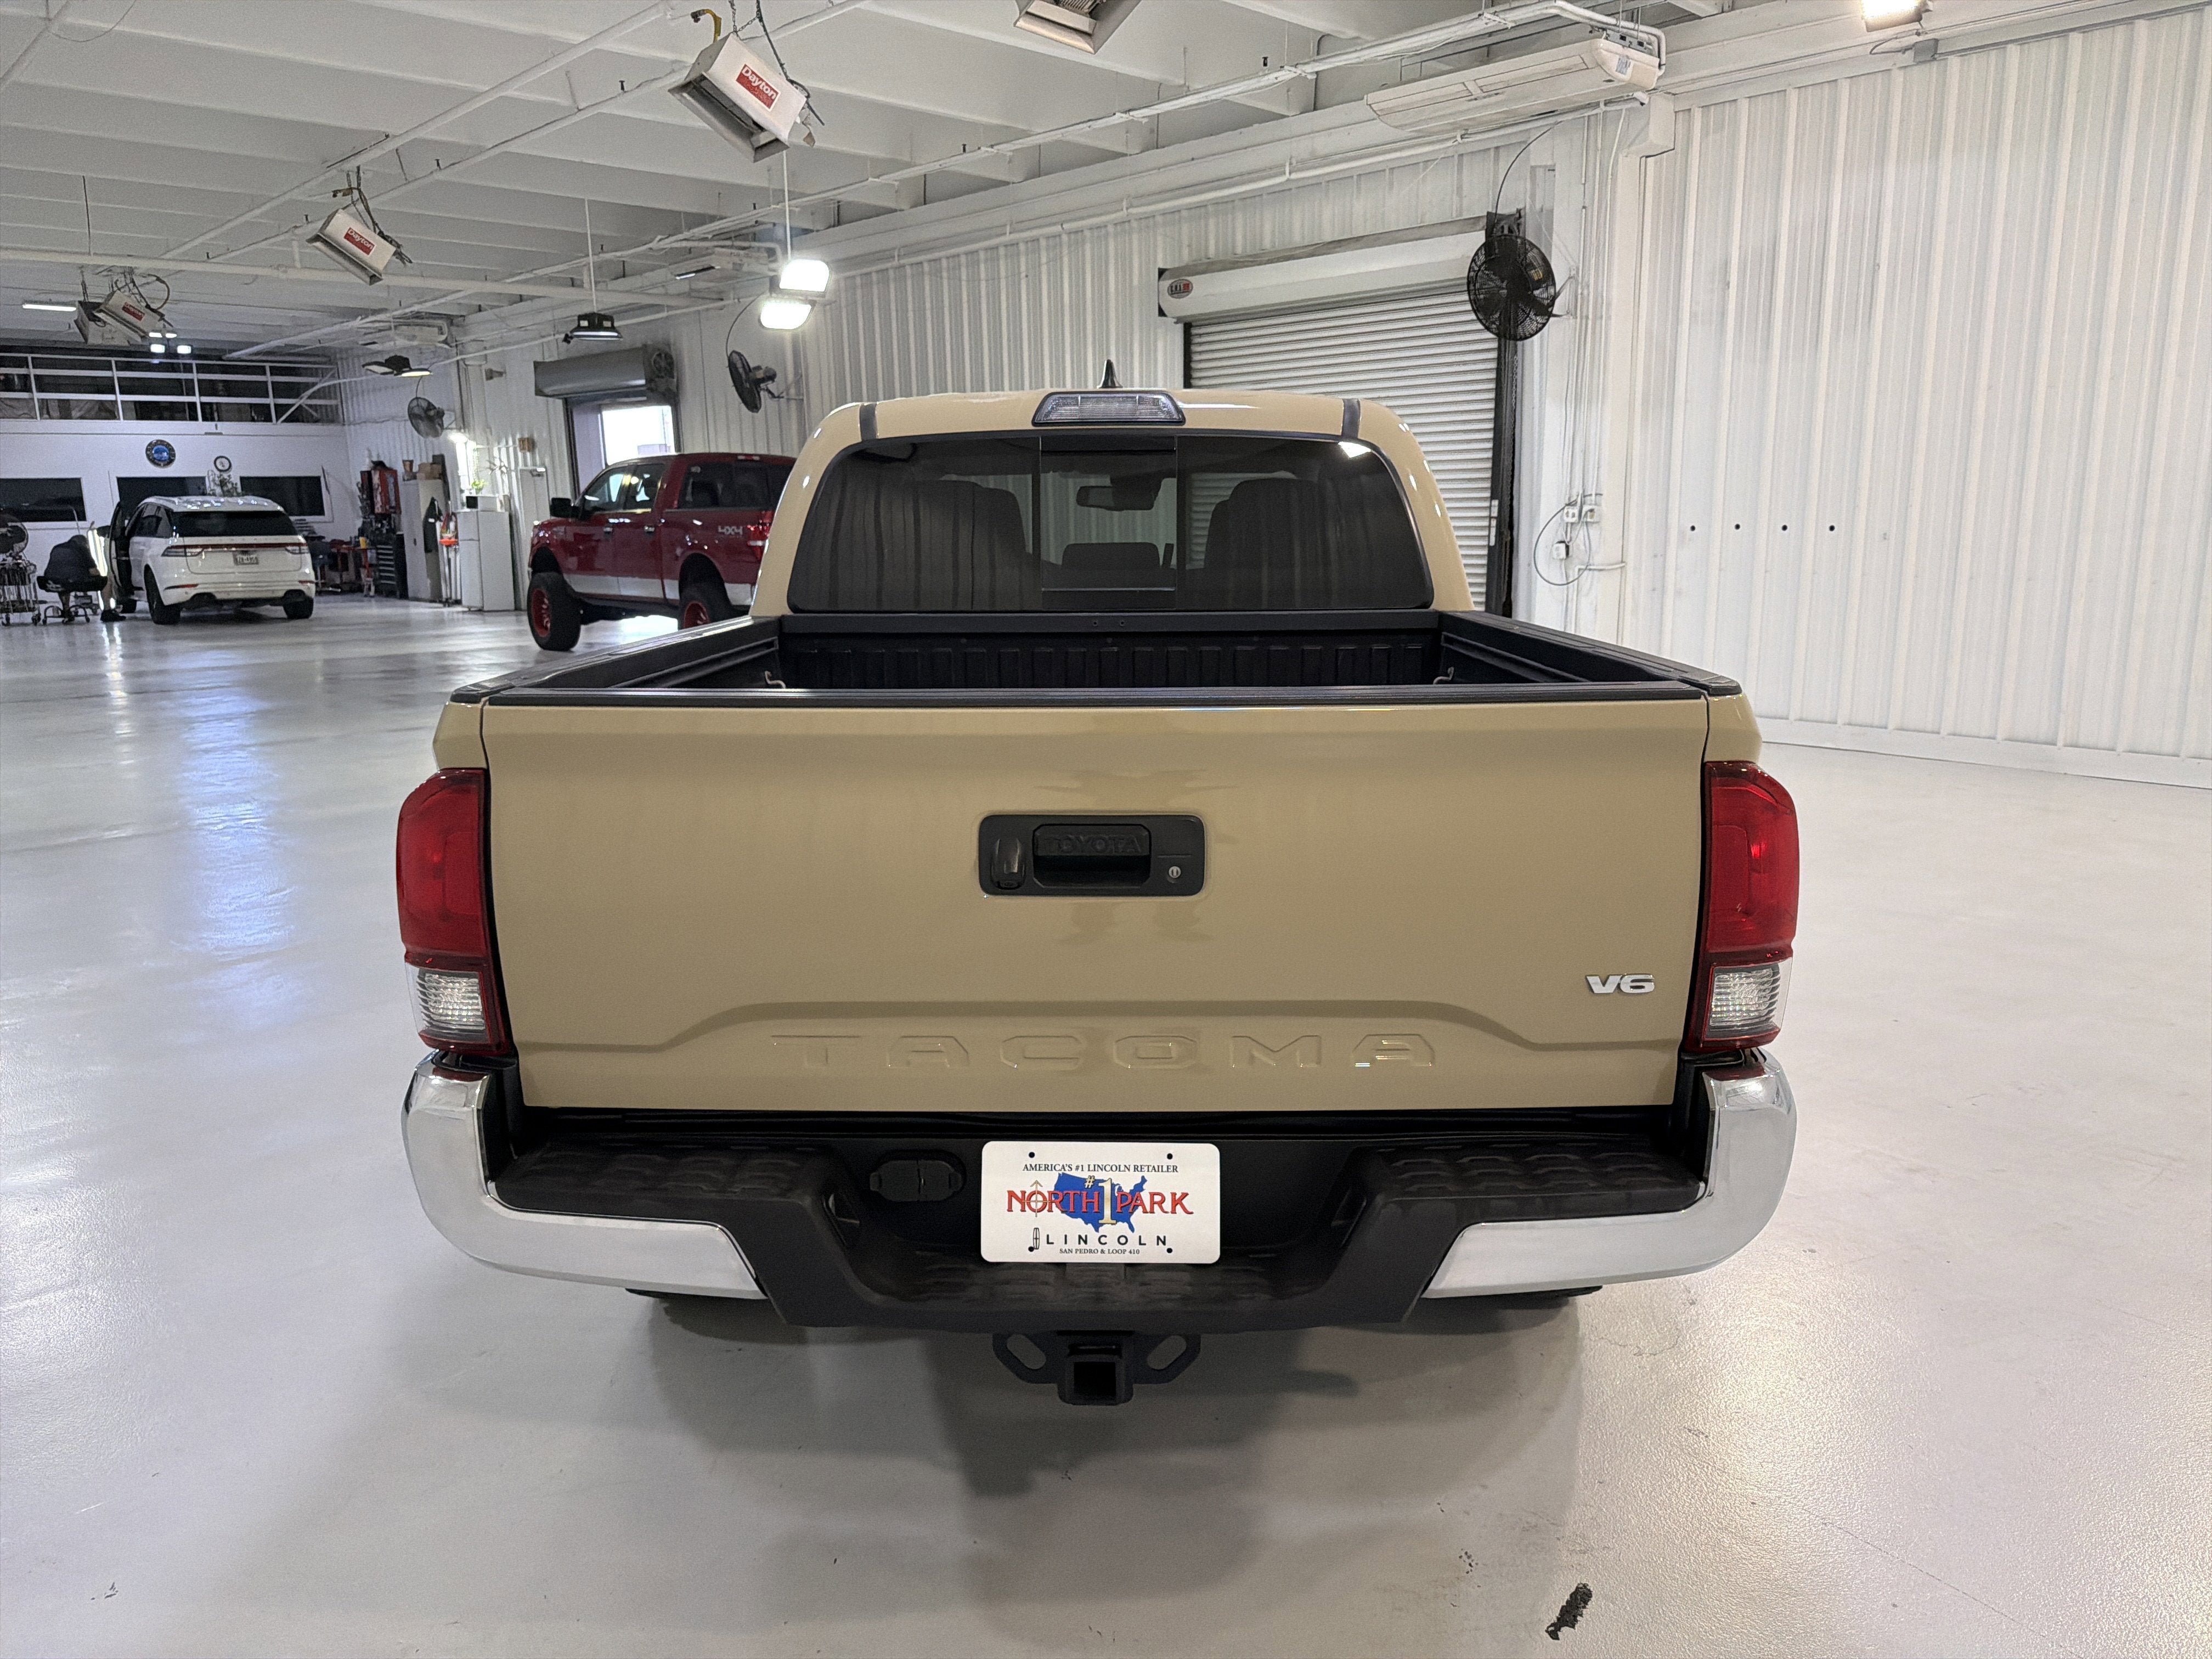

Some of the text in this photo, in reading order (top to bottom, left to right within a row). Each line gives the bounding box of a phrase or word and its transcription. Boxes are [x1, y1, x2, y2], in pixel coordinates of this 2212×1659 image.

[741, 66, 777, 100] Dayton
[347, 229, 373, 250] Dayton
[1043, 834, 1142, 854] TOYOTA
[1585, 973, 1655, 994] V6
[770, 1034, 1435, 1070] TACOMA
[1022, 1164, 1073, 1172] AMERICA'S
[1087, 1164, 1131, 1173] LINCOLN
[1133, 1164, 1179, 1173] RETAILER
[1006, 1190, 1194, 1215] NORTH PARK
[1046, 1234, 1167, 1246] LINCOLN
